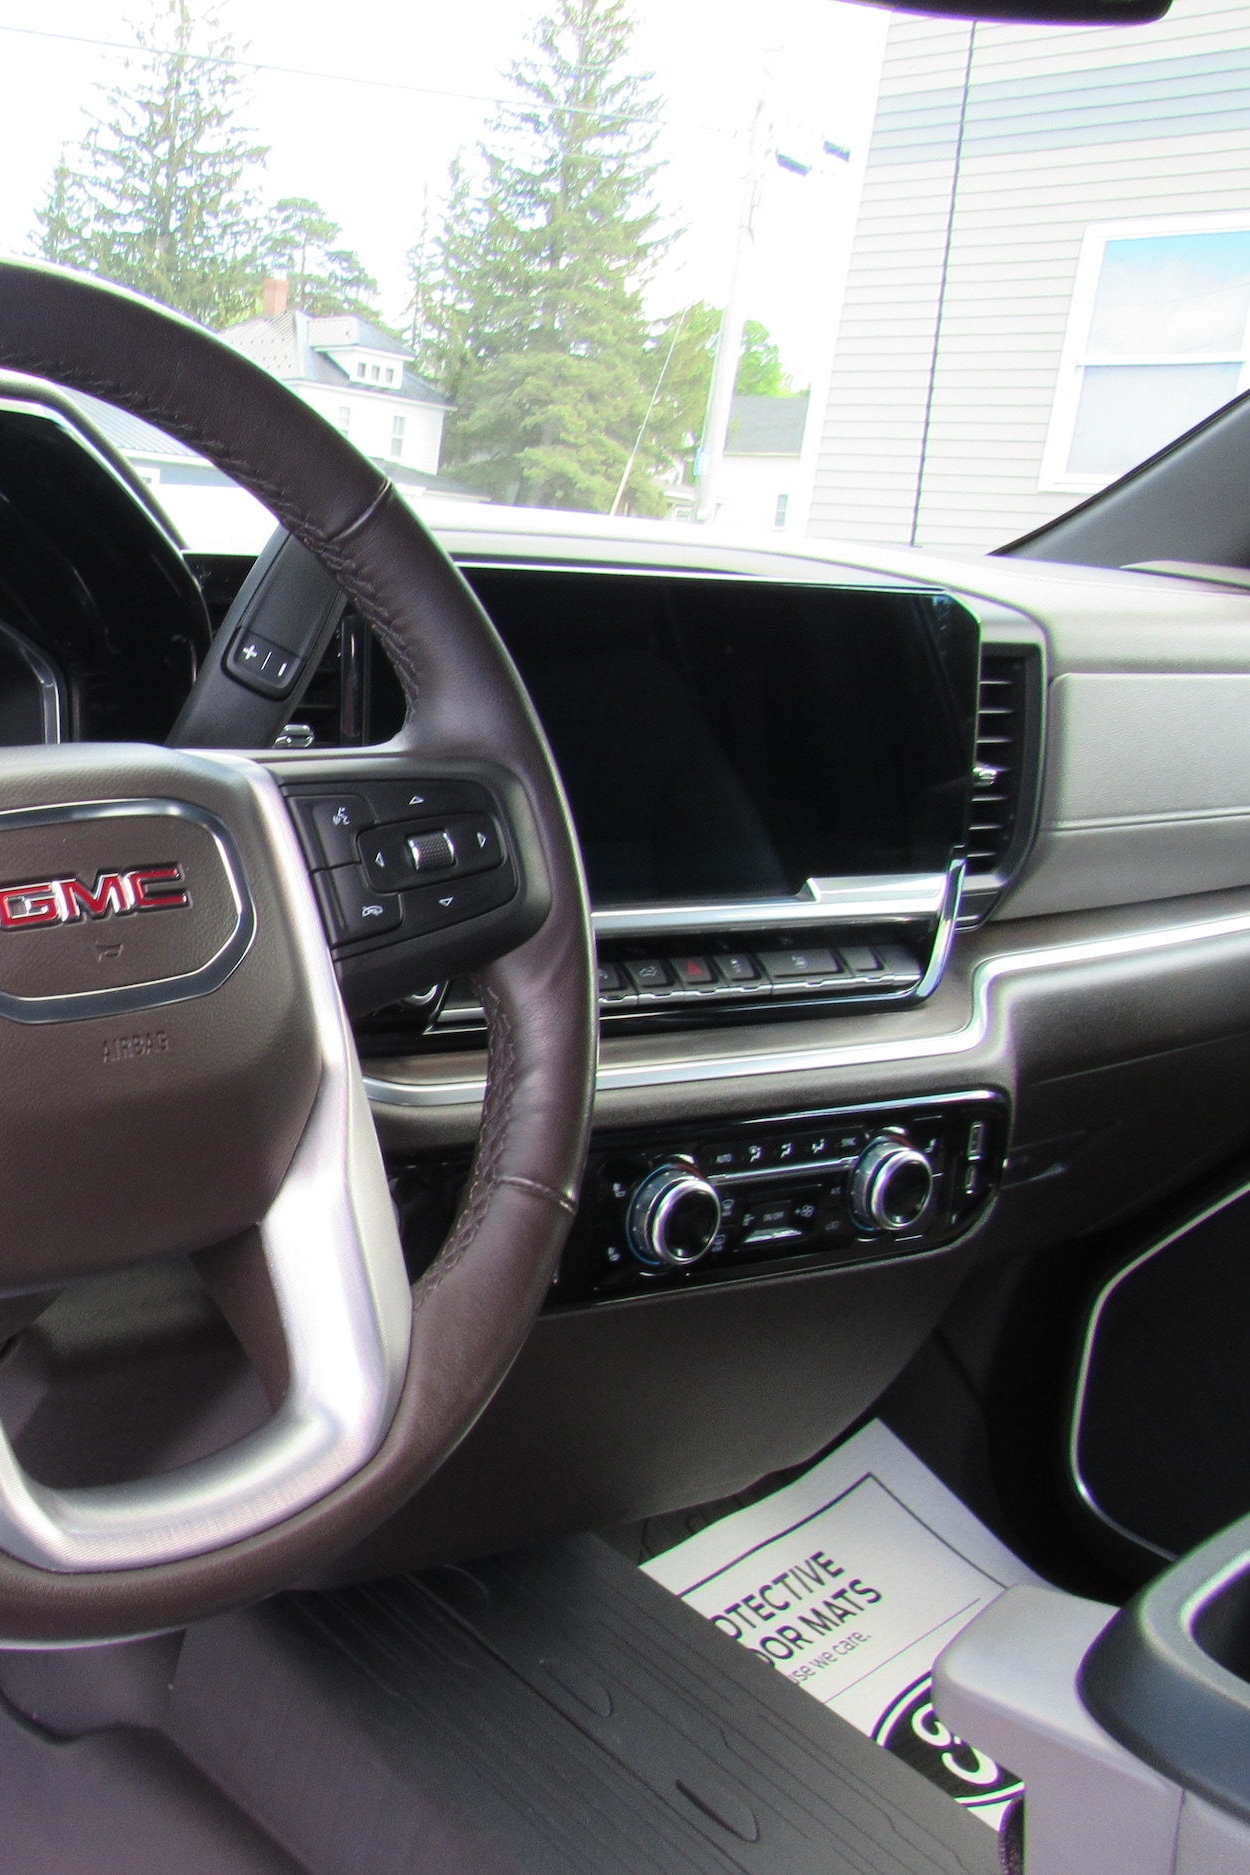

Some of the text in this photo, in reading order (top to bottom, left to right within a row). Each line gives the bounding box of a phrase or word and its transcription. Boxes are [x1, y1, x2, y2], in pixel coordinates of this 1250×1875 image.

[103, 1029, 169, 1063] AIRBAG
[797, 1578, 883, 1636] MATS
[808, 1651, 838, 1669] we
[832, 1631, 872, 1656] care.
